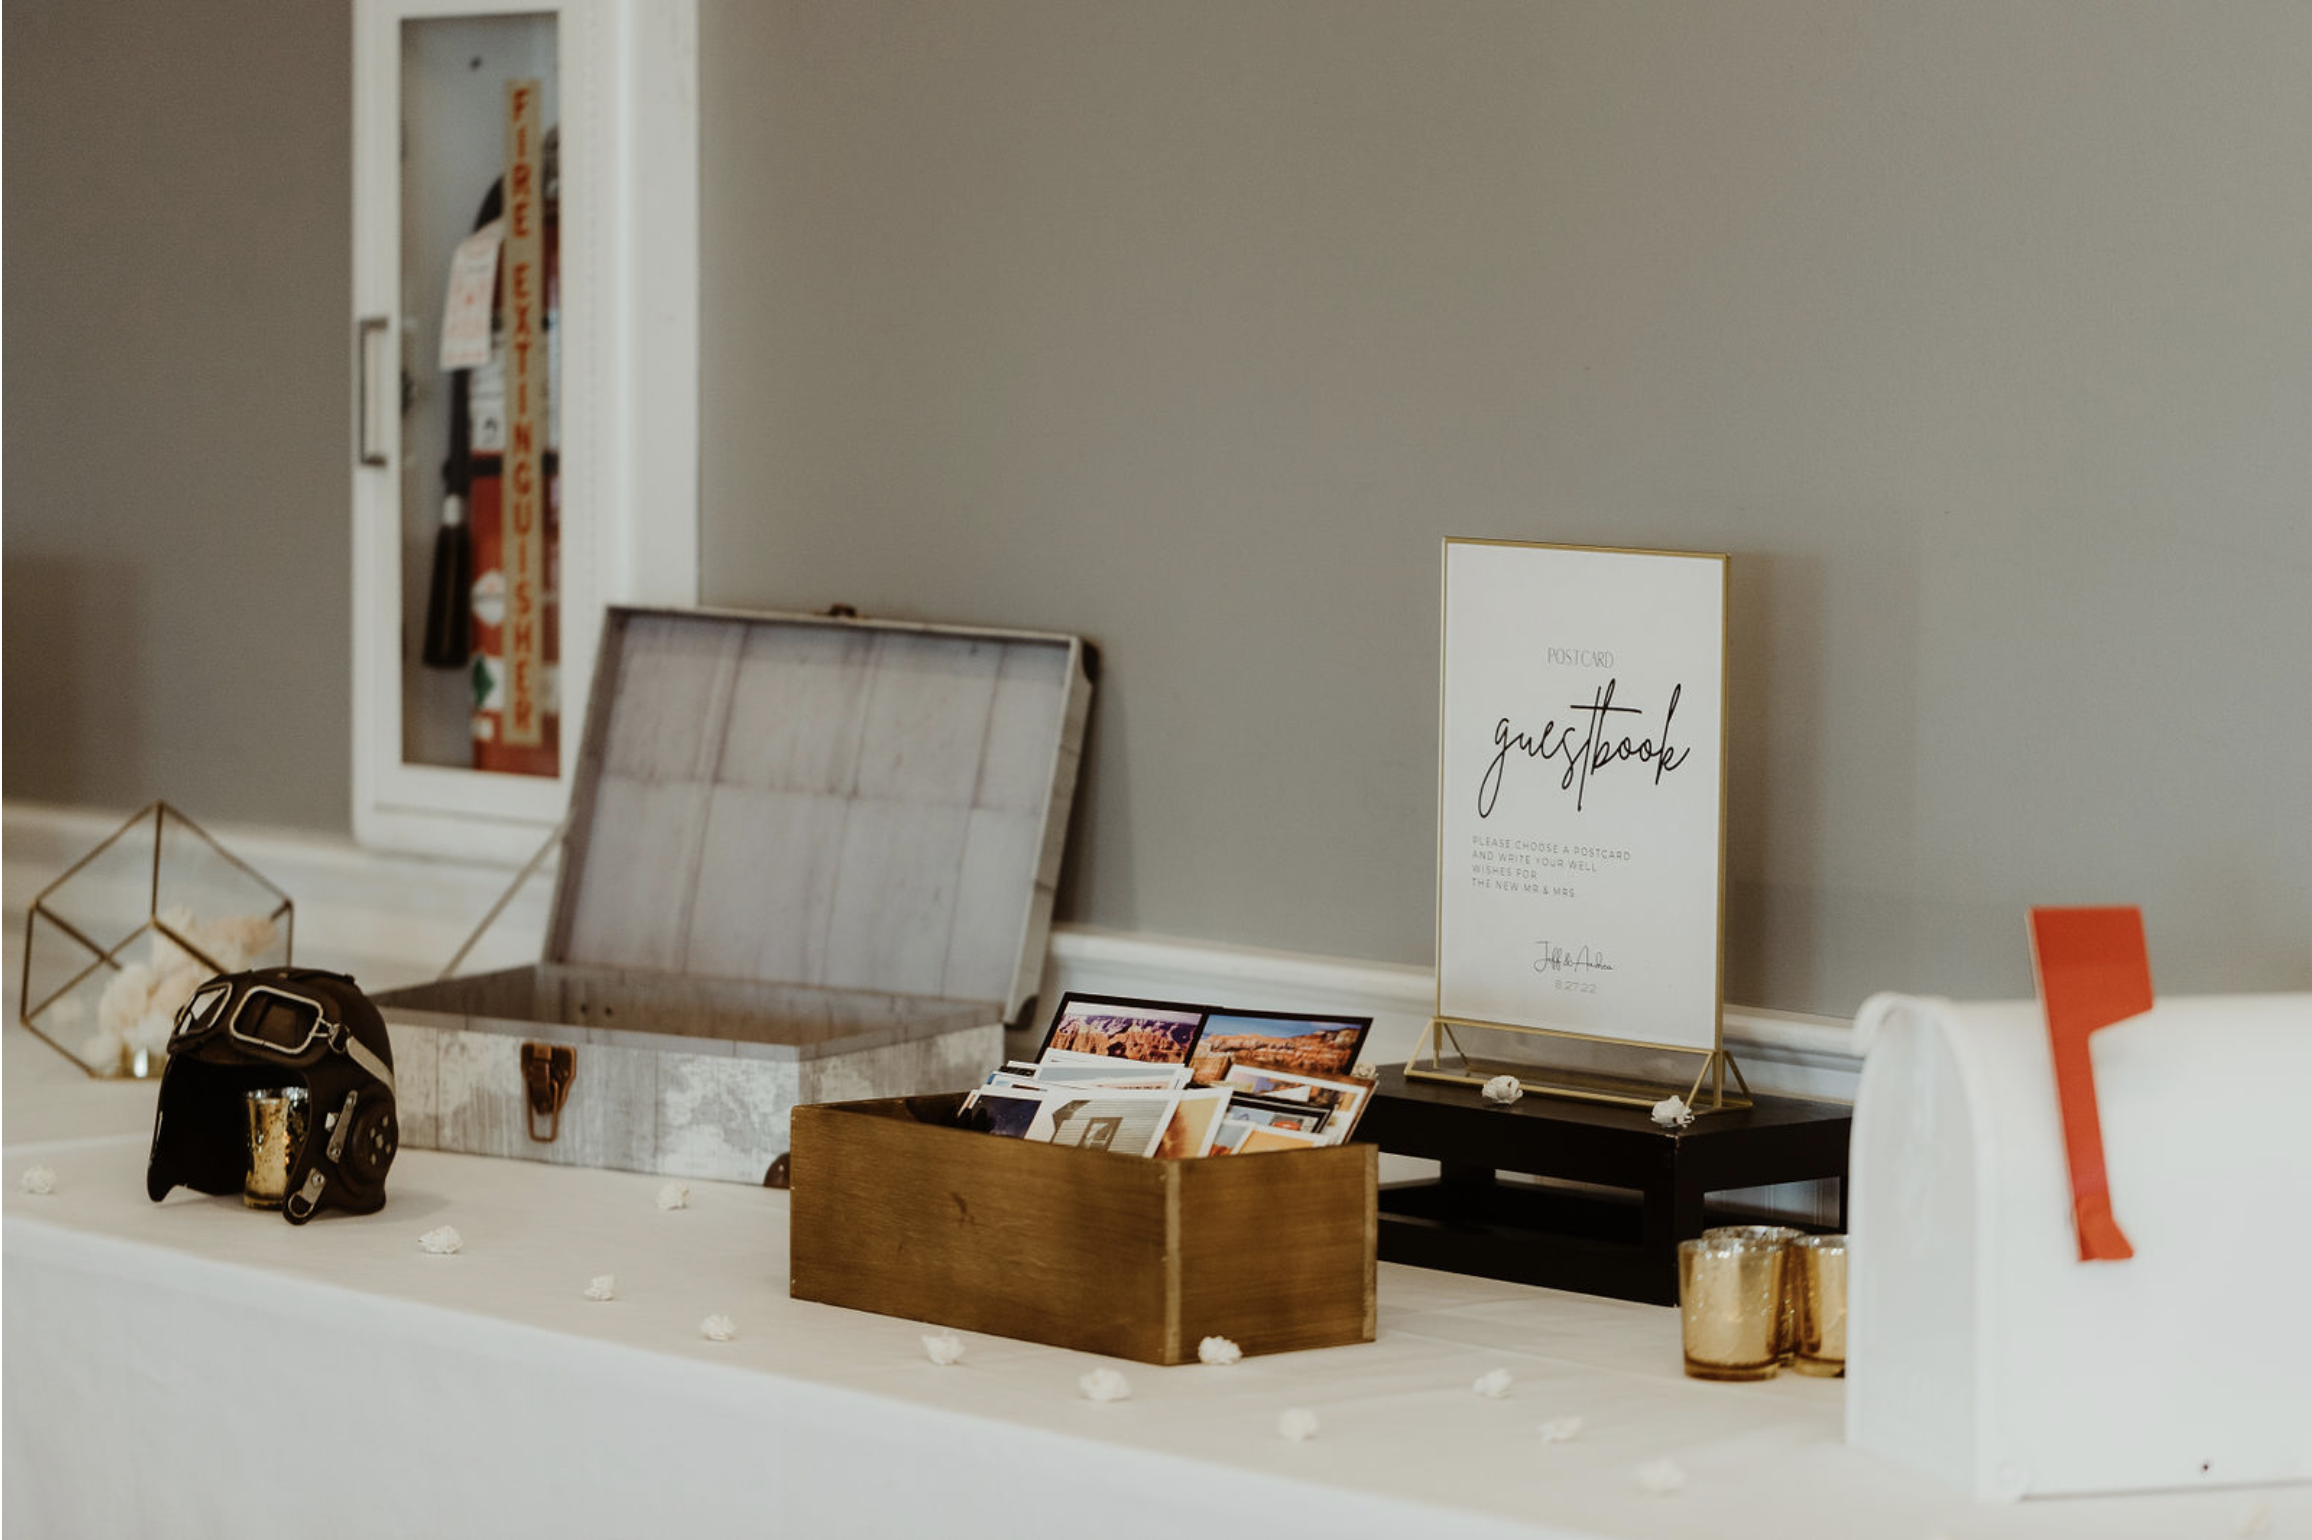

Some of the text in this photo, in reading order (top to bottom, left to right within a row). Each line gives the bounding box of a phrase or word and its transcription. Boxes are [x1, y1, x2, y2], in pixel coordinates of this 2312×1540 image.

[512, 87, 534, 733] FIRE EXTINGUISHER
[1547, 646, 1615, 669] POSTCARD
[1478, 677, 1691, 819] guestbook
[1472, 835, 1632, 861] PLEASE CHOOSE A POSTCARD
[1472, 850, 1598, 872] AND WRITE YOUR WELL
[1472, 865, 1537, 879] WISHES FOR
[1472, 877, 1491, 888] THE
[1495, 880, 1519, 892] NEW
[1523, 884, 1539, 893] MR
[1553, 887, 1576, 898] MRS
